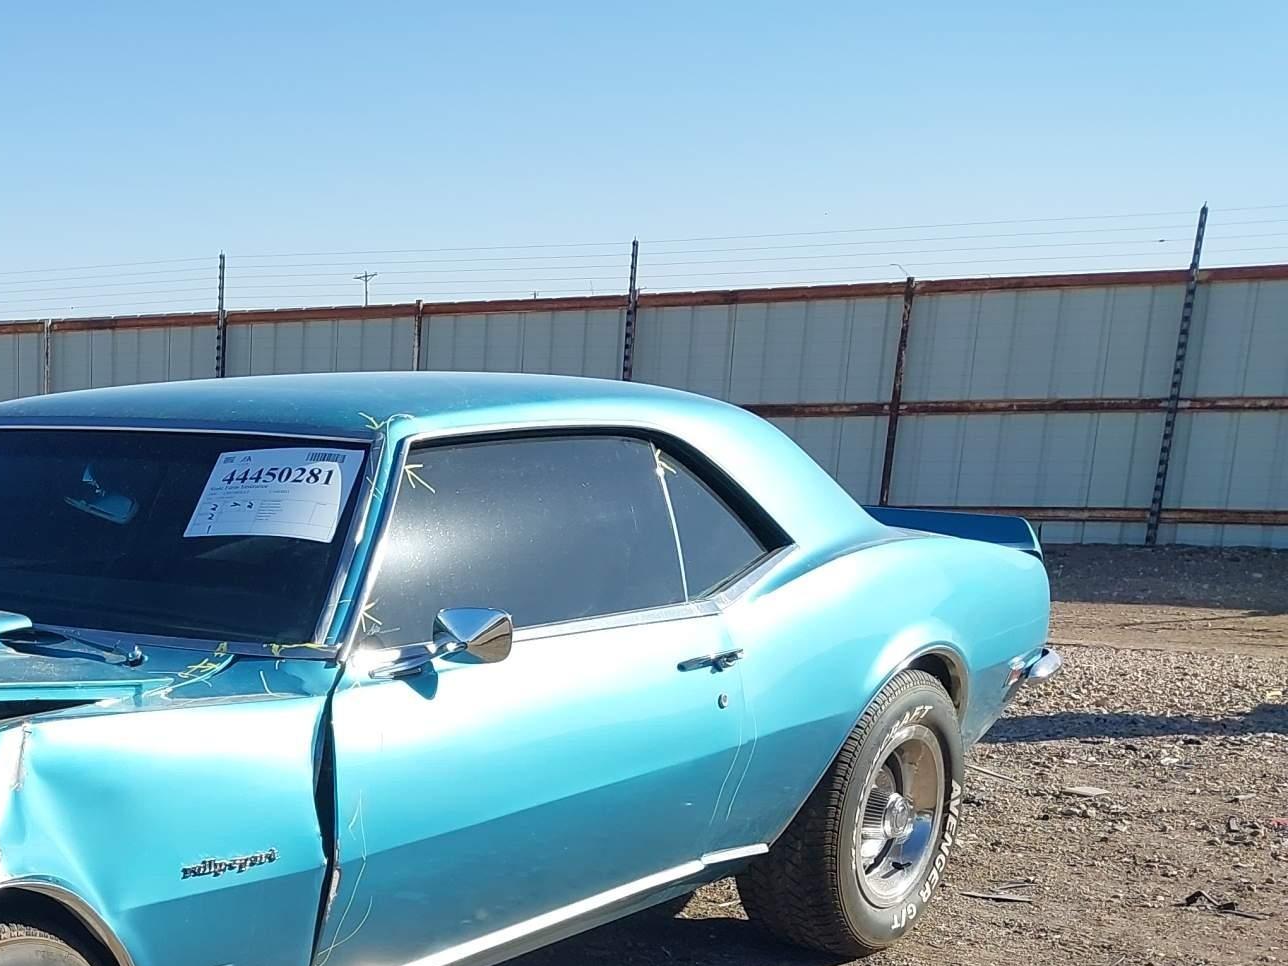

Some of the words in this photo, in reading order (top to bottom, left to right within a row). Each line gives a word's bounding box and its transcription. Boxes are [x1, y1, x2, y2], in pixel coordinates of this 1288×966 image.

[222, 467, 334, 486] 44450281
[919, 778, 962, 903] AVENGER
[891, 903, 917, 930] G/T
